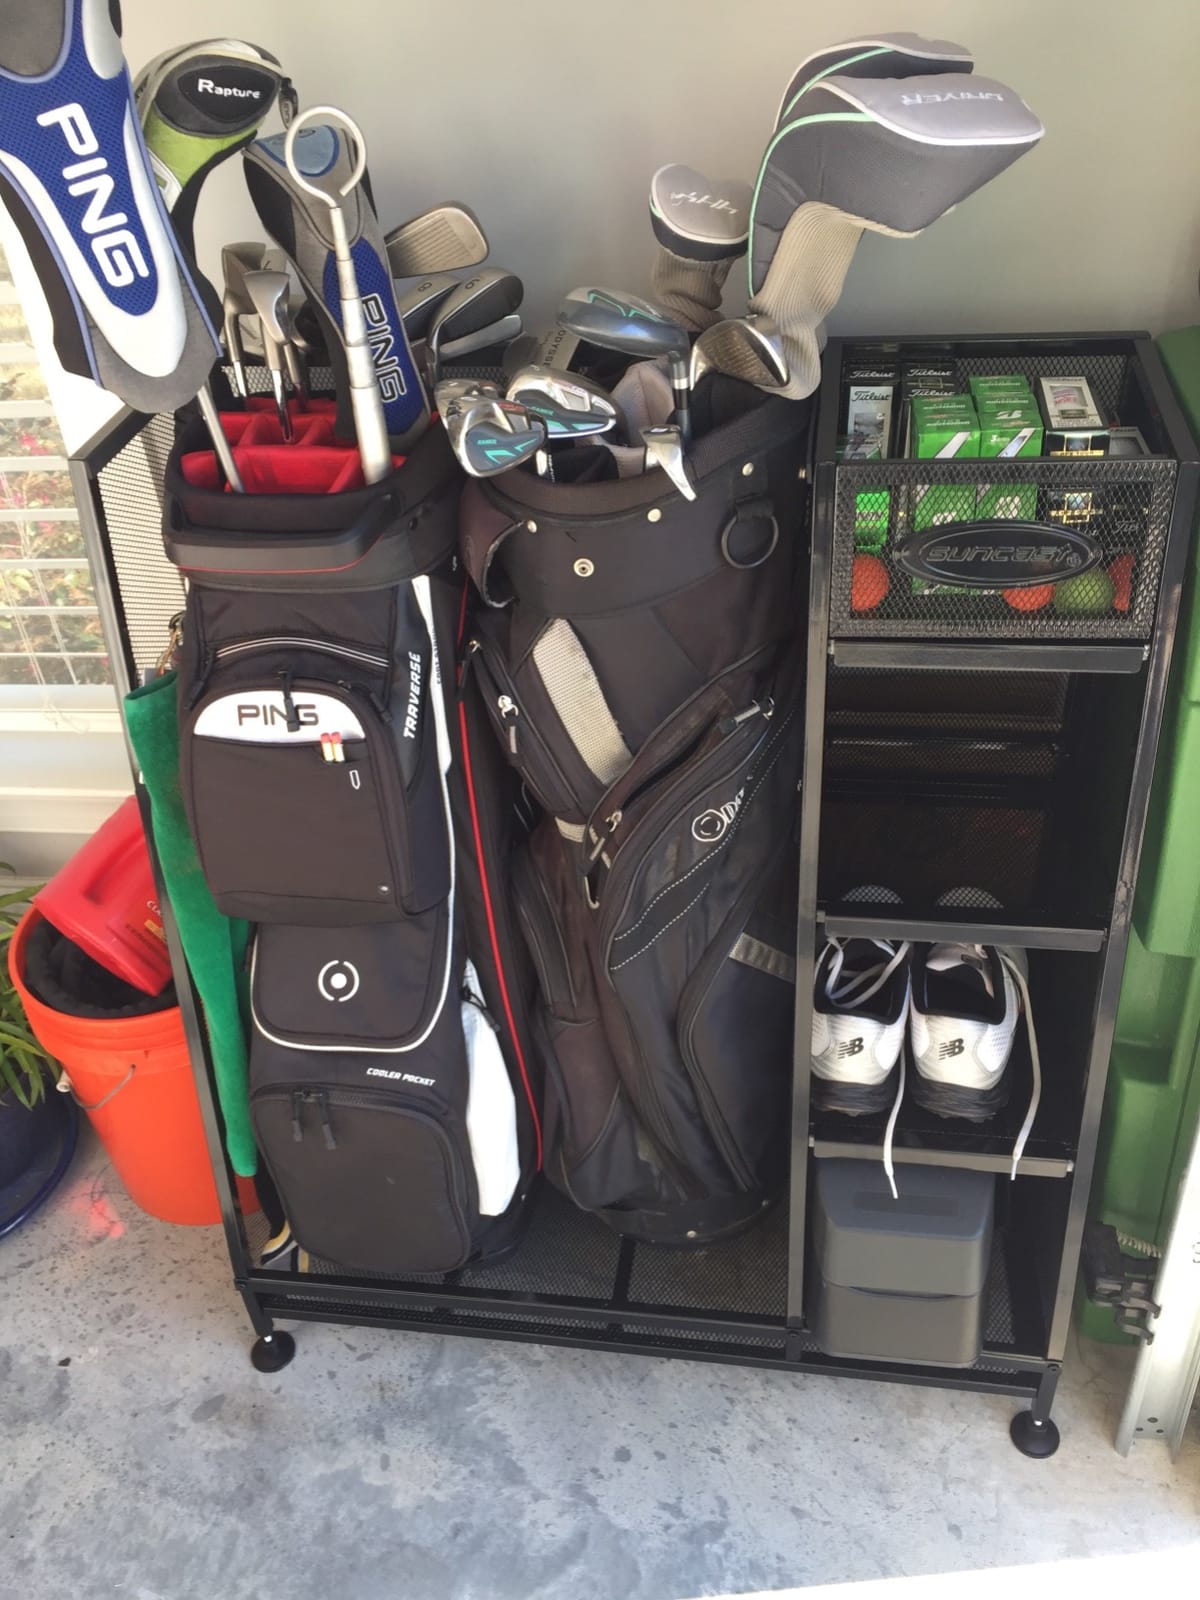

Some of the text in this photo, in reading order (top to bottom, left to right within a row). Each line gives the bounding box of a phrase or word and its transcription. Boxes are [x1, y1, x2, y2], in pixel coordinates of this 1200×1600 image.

[197, 78, 261, 100] Rapture
[36, 102, 150, 288] PING
[360, 293, 407, 403] PING
[237, 704, 319, 726] PING
[403, 651, 421, 739] TRAVERSE
[366, 1067, 436, 1087] COOLER POCKET
